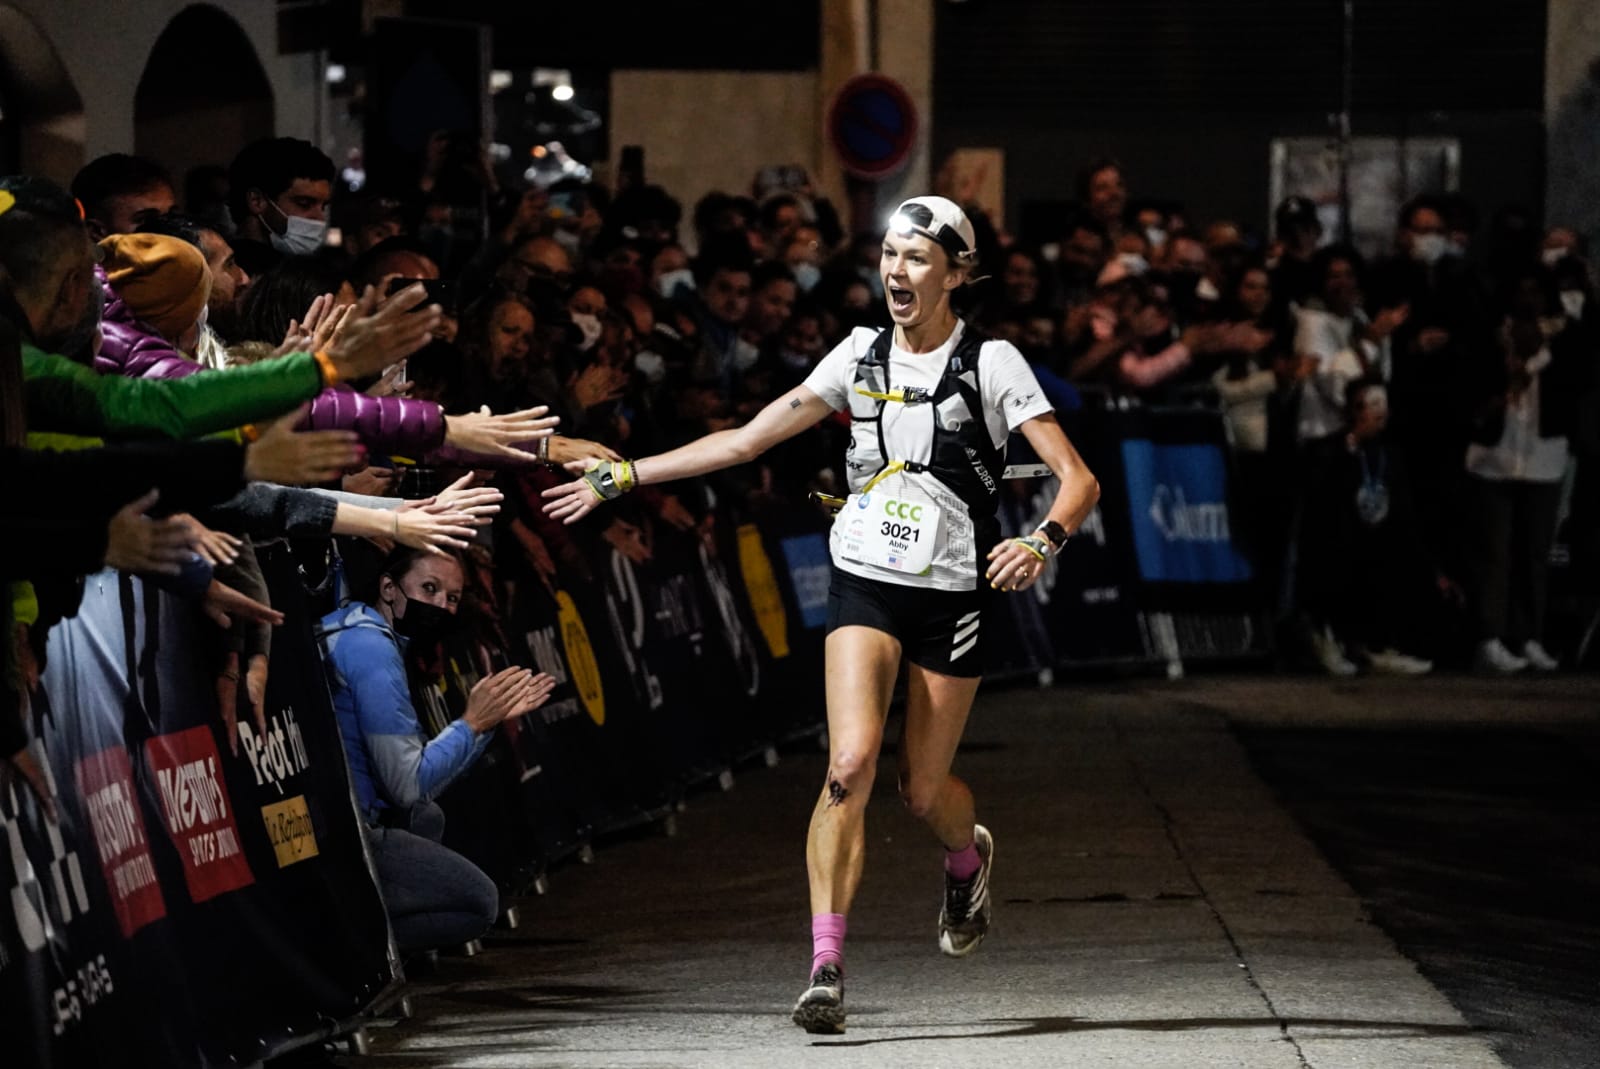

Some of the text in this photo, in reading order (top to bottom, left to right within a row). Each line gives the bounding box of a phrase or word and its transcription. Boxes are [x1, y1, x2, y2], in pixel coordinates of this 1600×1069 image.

[885, 500, 922, 522] CCC
[880, 521, 920, 543] 3021
[889, 540, 909, 551] Abby
